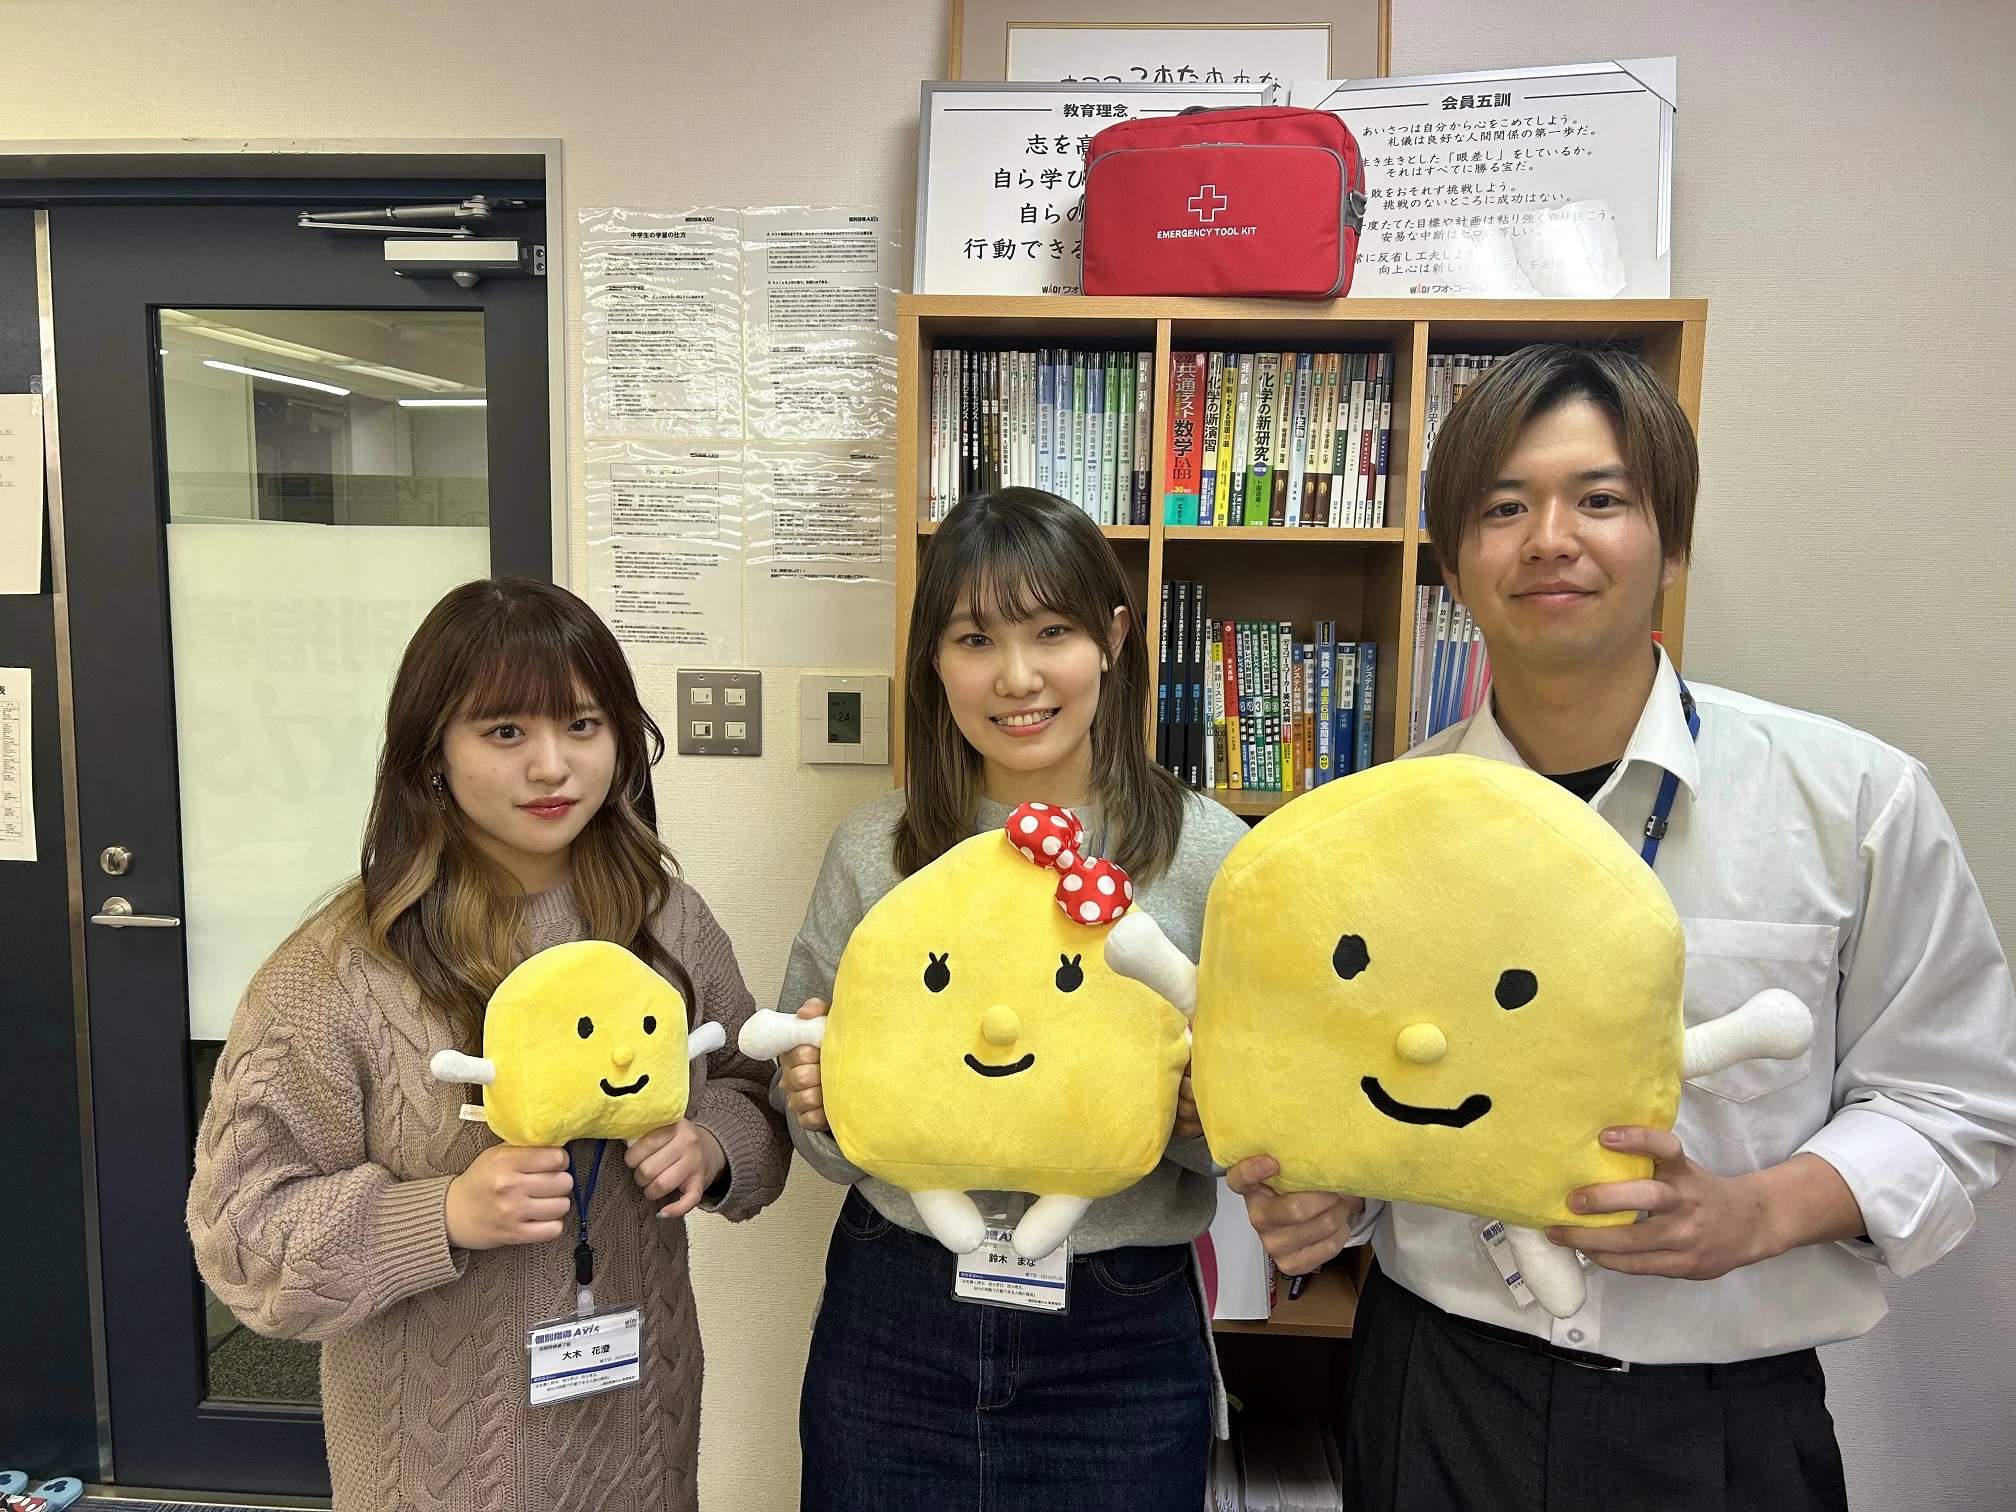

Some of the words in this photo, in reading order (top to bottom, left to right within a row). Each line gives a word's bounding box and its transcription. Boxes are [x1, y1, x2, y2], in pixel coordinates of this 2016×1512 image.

[1063, 103, 1128, 118] 教育理念
[1441, 93, 1511, 111] 会員五訓
[1362, 114, 1579, 137] あいさつは自分から心をこめてしよう。
[1387, 125, 1598, 148] 礼儀は良好な人間関係の第一歩だ。
[1386, 160, 1535, 178] それはすべてに勝る宝だ。
[1364, 181, 1517, 200] 敗をおそれず挑戦しよう。
[1383, 193, 1573, 211] 挑戦のないところに成功はない。
[630, 231, 686, 239] 中学生の学習の仕方
[1157, 228, 1213, 239] EMERGENCY
[1214, 227, 1240, 236] TOOL
[1241, 226, 1257, 235] KIT
[1176, 364, 1197, 419] 共通テスト
[1204, 376, 1222, 453] 化学の新演習
[1254, 371, 1275, 462] 化学の新研究
[1172, 419, 1195, 457] 数学
[1295, 416, 1306, 438] 生物
[1214, 664, 1223, 718] 英語リスニング
[1282, 638, 1291, 723] ディスコースマーカー英文読解
[1344, 659, 1353, 708] 速読英単語
[1363, 665, 1373, 711] システム英単語
[988, 1253, 1008, 1264] 鈴木
[562, 1349, 582, 1361] 大木
[591, 1343, 611, 1356] 花澄
